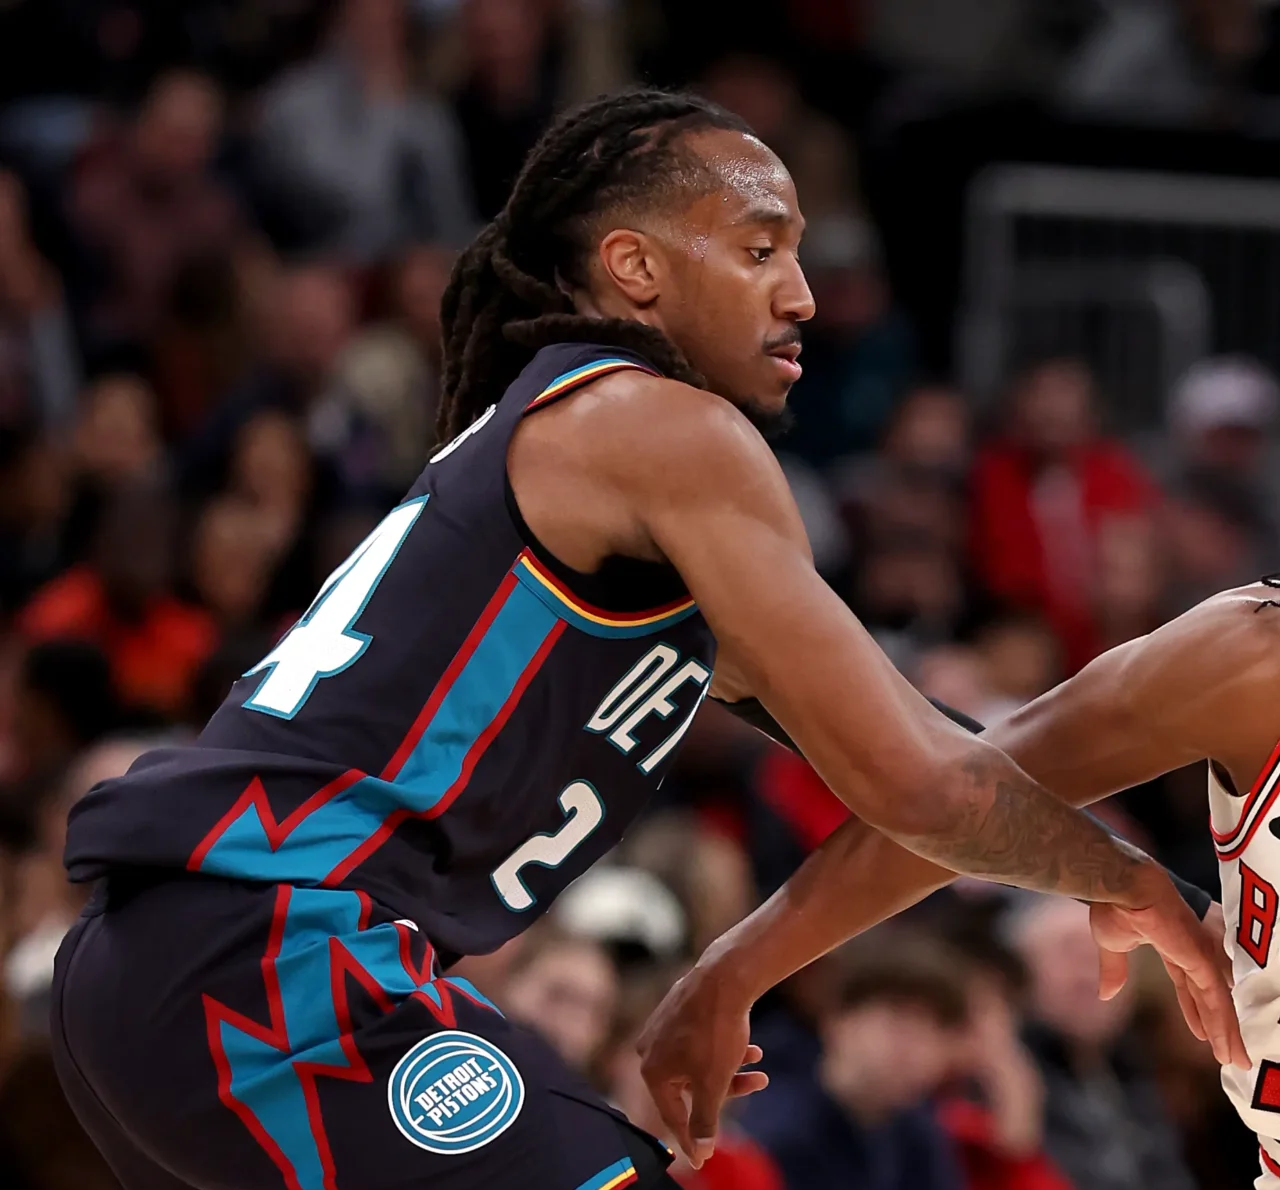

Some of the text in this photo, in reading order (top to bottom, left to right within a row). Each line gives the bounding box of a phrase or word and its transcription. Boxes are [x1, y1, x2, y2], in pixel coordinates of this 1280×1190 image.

[489, 778, 605, 912] 2
[413, 1056, 483, 1112] DETROIT
[426, 1071, 498, 1127] PISTONS
